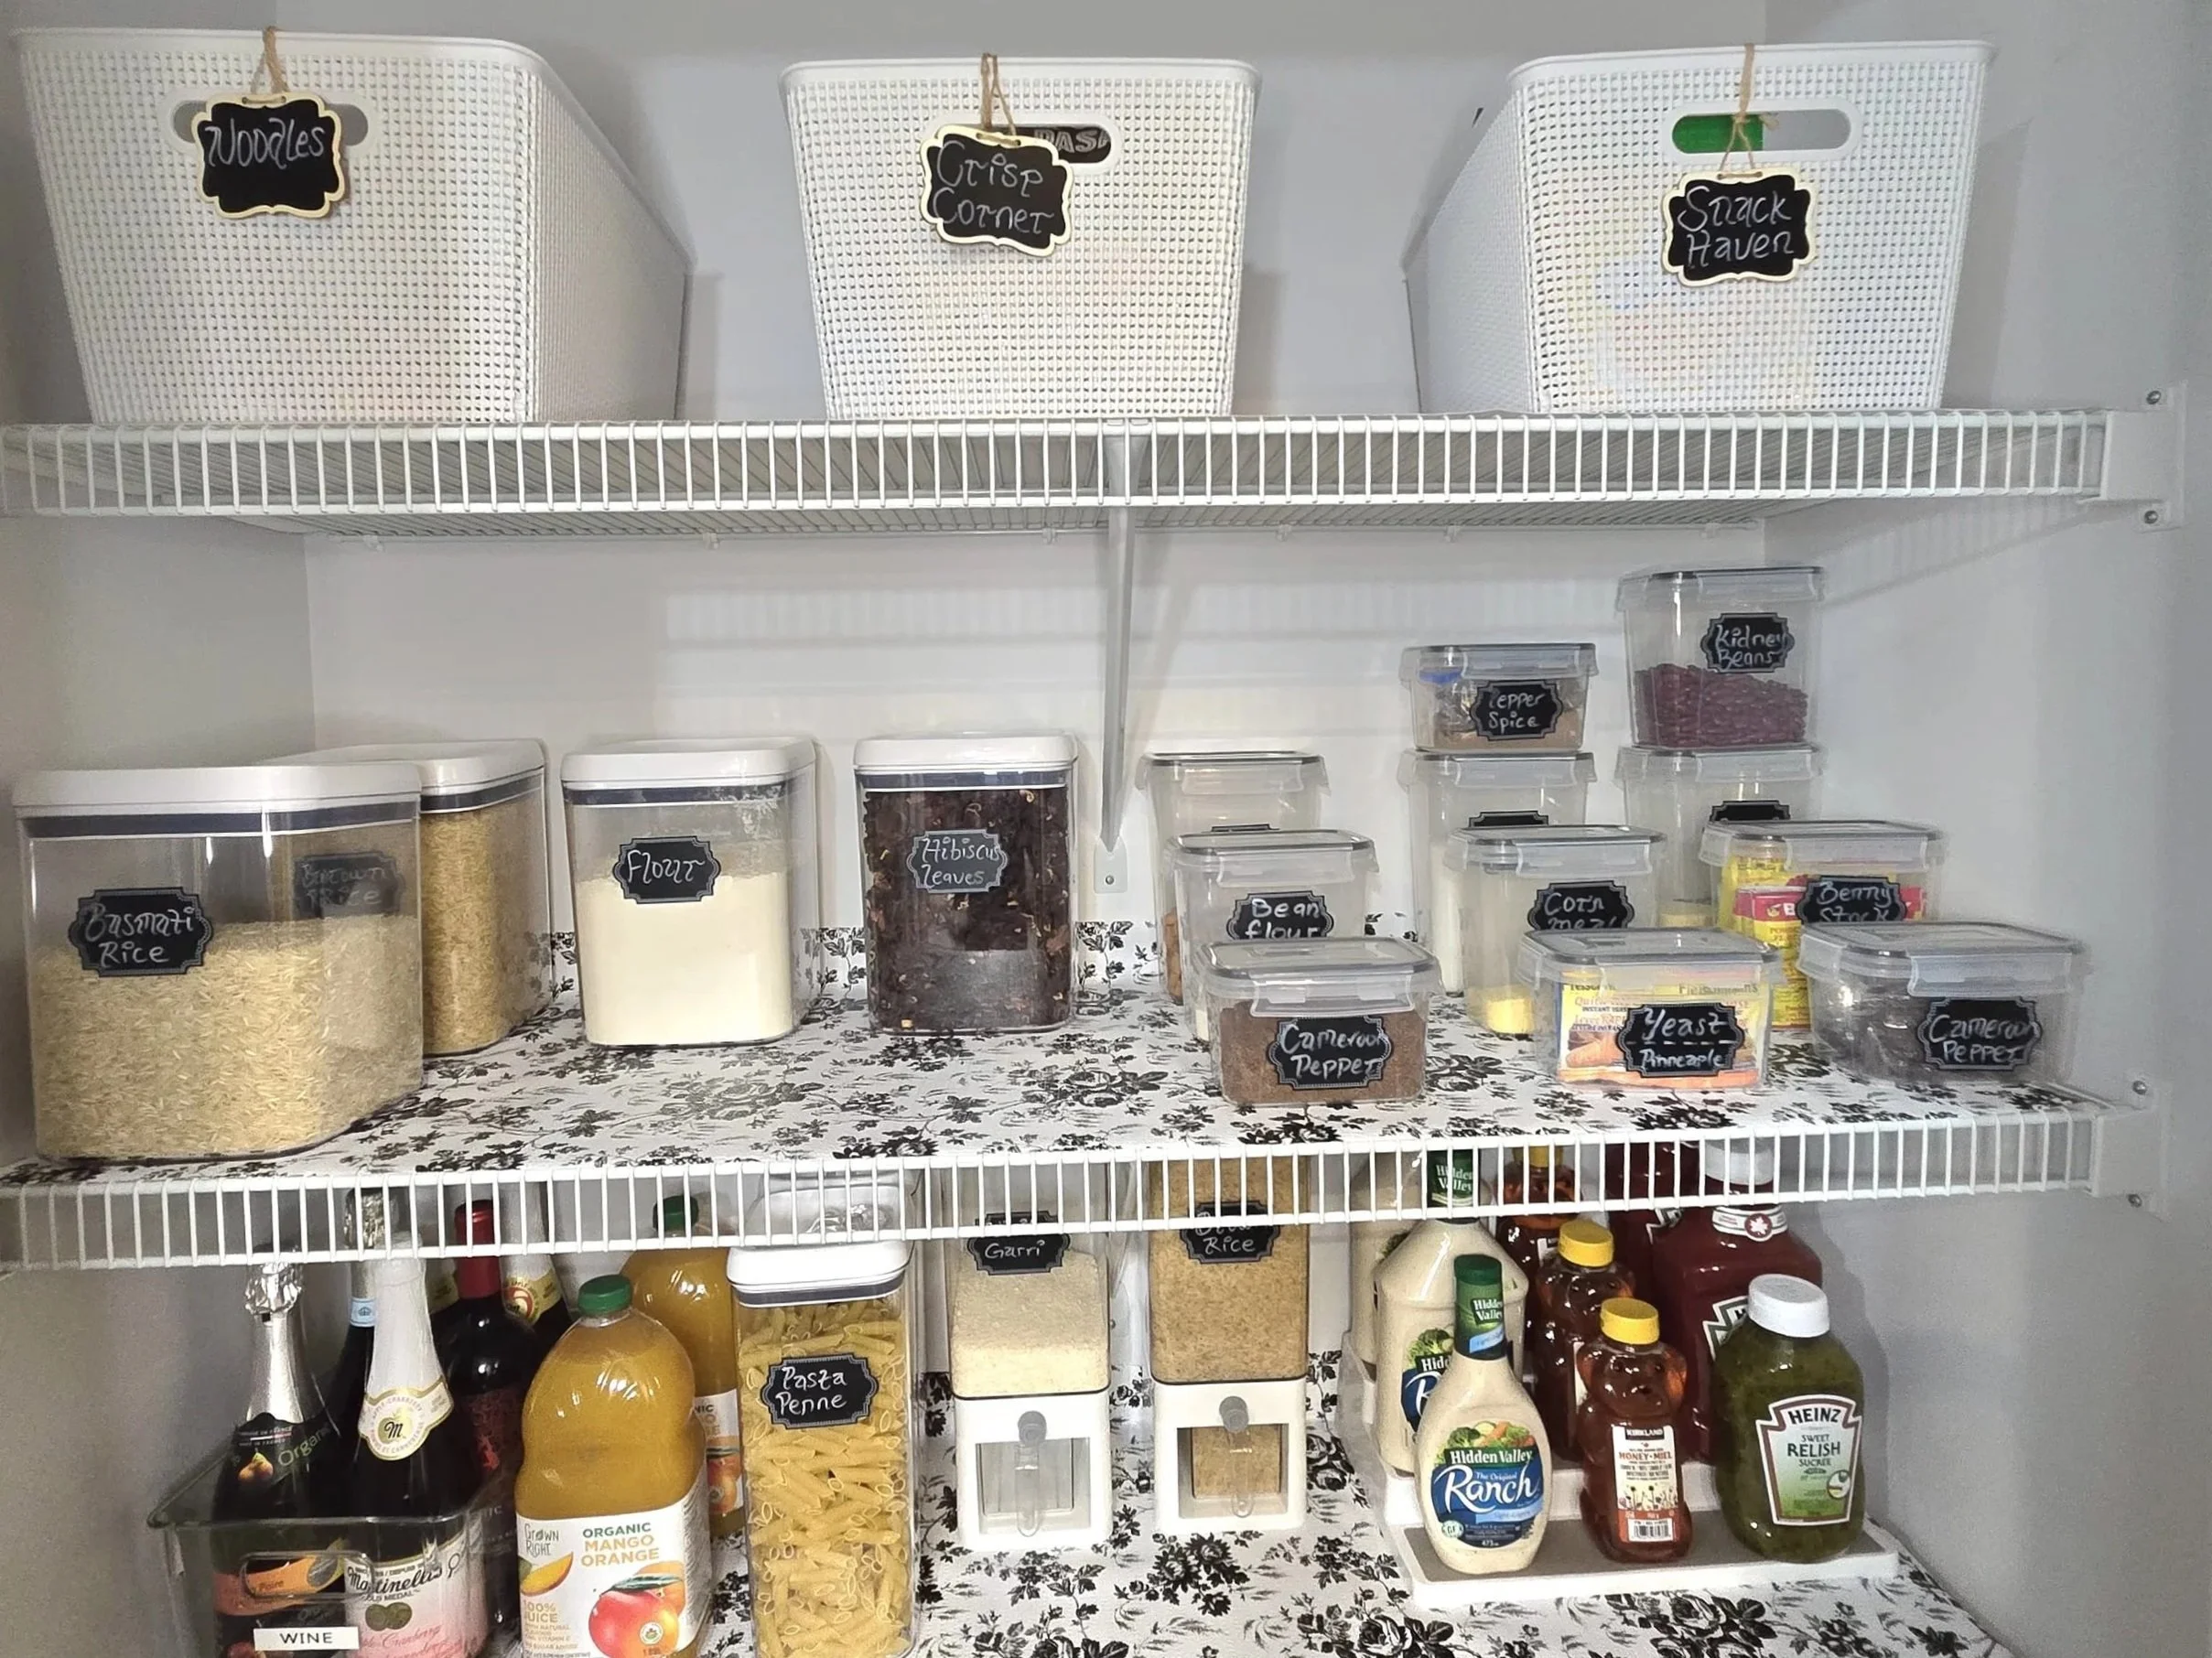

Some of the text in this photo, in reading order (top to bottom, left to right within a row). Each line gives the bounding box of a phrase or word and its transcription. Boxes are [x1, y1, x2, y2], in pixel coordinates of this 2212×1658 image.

[204, 117, 326, 169] Noodles
[937, 140, 1043, 197] Crisp
[933, 187, 1054, 234] Corner
[1677, 186, 1791, 231] Snack
[1687, 230, 1794, 268] Haven
[1717, 648, 1775, 670] Beans
[1489, 712, 1540, 734] Spice
[923, 836, 1000, 862] Hibiscus
[628, 849, 705, 884] Flour
[1251, 898, 1320, 919] Bean
[1544, 892, 1605, 915] Corn
[85, 903, 195, 942] Basmati
[98, 941, 168, 967] Rice
[1641, 1007, 1729, 1040] Yeast
[1290, 1054, 1384, 1079] Pepper
[985, 1240, 1046, 1258] Garri
[1203, 1236, 1256, 1254] Rice
[782, 1366, 847, 1390] Pasta
[775, 1392, 847, 1416] Penne
[1788, 1407, 1841, 1425] HEINZ
[1787, 1441, 1840, 1458] RELISH
[1801, 1434, 1829, 1443] SWEET
[1450, 1448, 1533, 1464] Hidden Valley
[1434, 1464, 1540, 1513] Ranch
[582, 1522, 653, 1539] ORGANIC
[584, 1534, 655, 1553] MANGO
[580, 1547, 660, 1566] ORANGE
[279, 1631, 334, 1644] WINE
